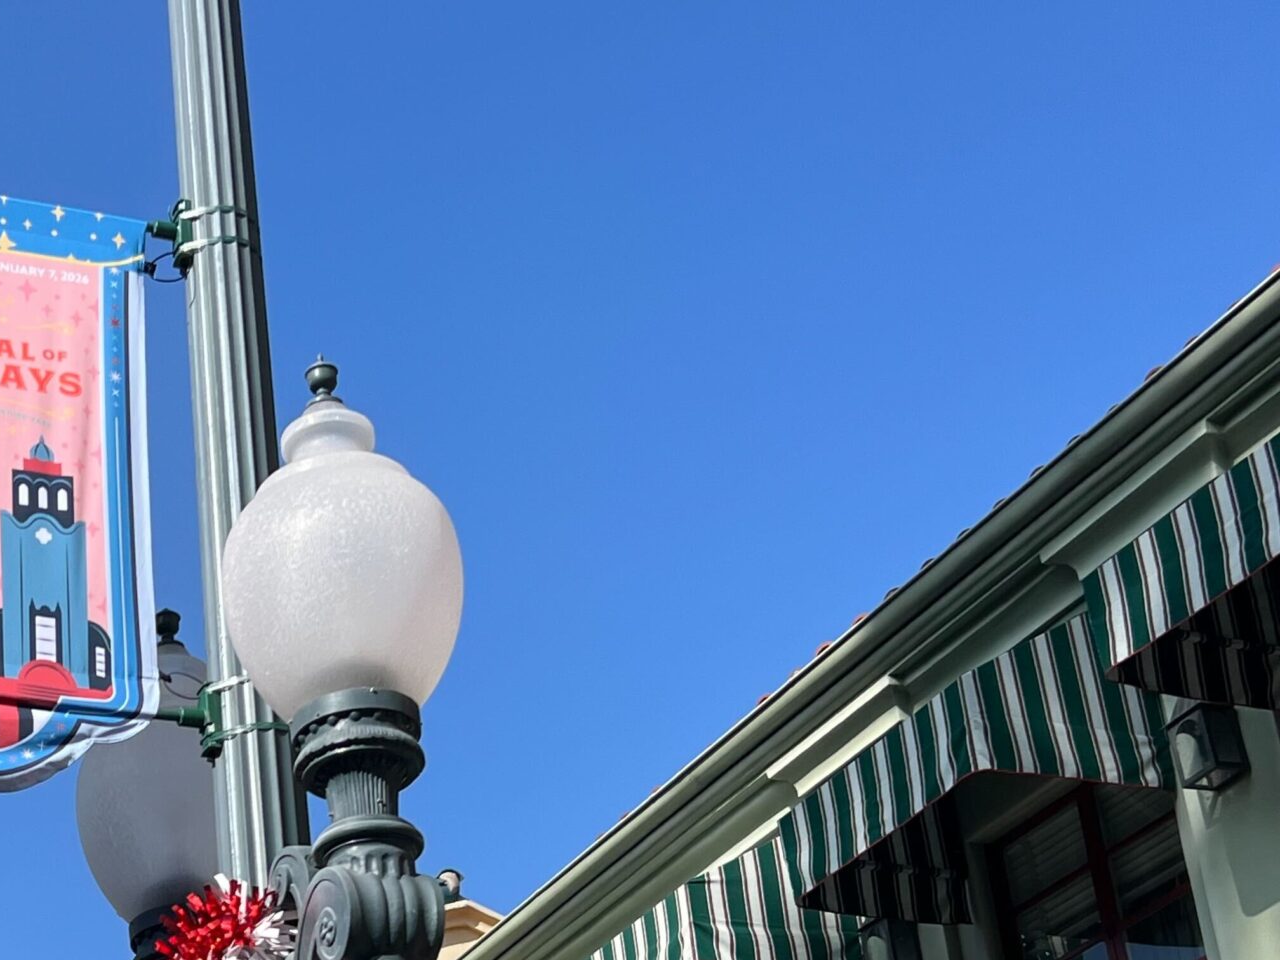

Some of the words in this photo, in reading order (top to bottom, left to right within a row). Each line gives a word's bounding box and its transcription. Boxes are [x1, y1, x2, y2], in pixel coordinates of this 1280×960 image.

[48, 269, 58, 279] 7,
[61, 271, 89, 284] 2026
[42, 349, 67, 362] OF
